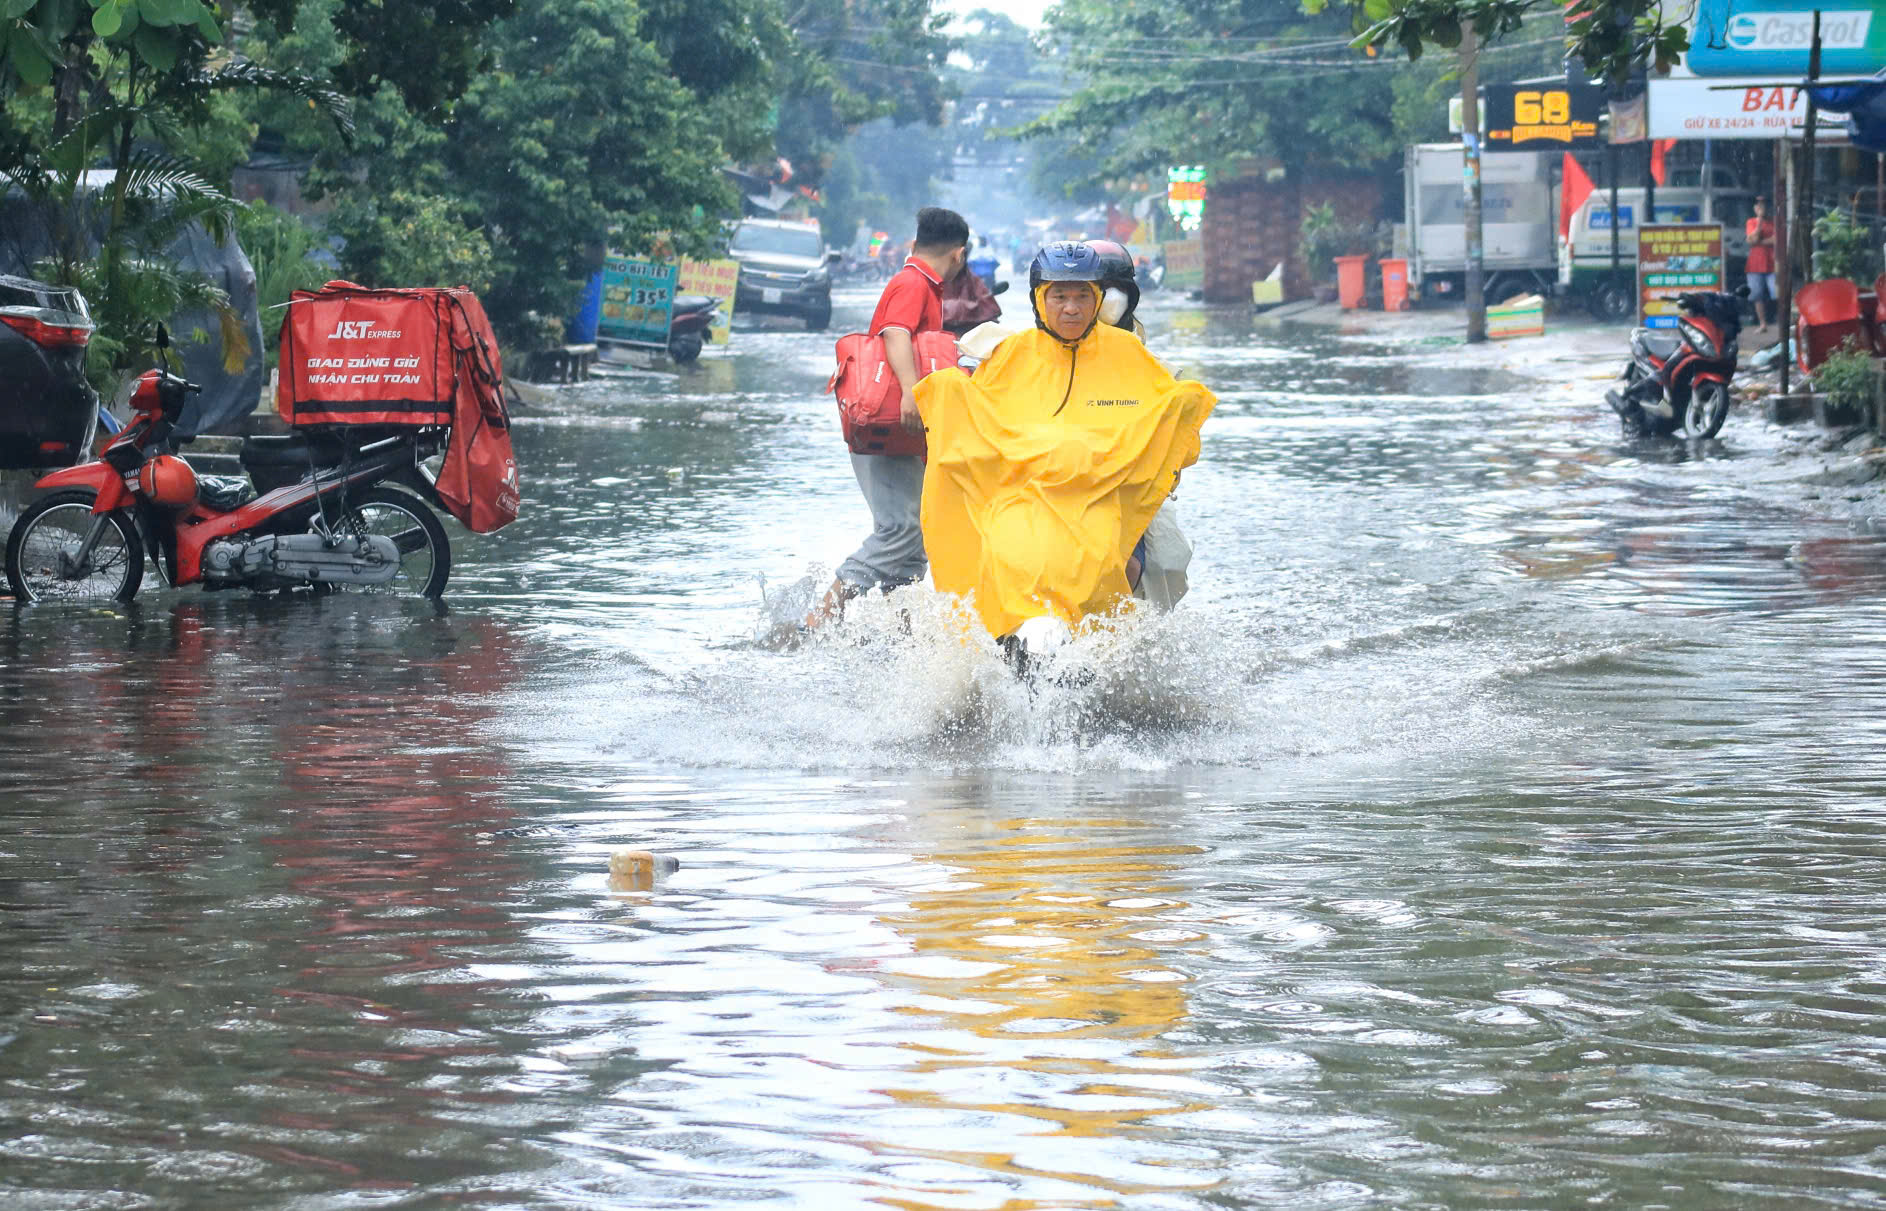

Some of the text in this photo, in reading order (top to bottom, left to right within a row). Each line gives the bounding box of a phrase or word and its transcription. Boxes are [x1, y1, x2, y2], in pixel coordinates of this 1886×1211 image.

[1762, 16, 1861, 45] Casrol
[1515, 91, 1570, 124] 68
[1709, 117, 1721, 128] XE
[1724, 117, 1755, 128] 24/24
[328, 321, 402, 339] J&T EXPRESS
[308, 354, 420, 368] GIAO ĐÚNG GIỜ
[309, 373, 347, 386] NHẬN
[350, 375, 379, 384] CHU
